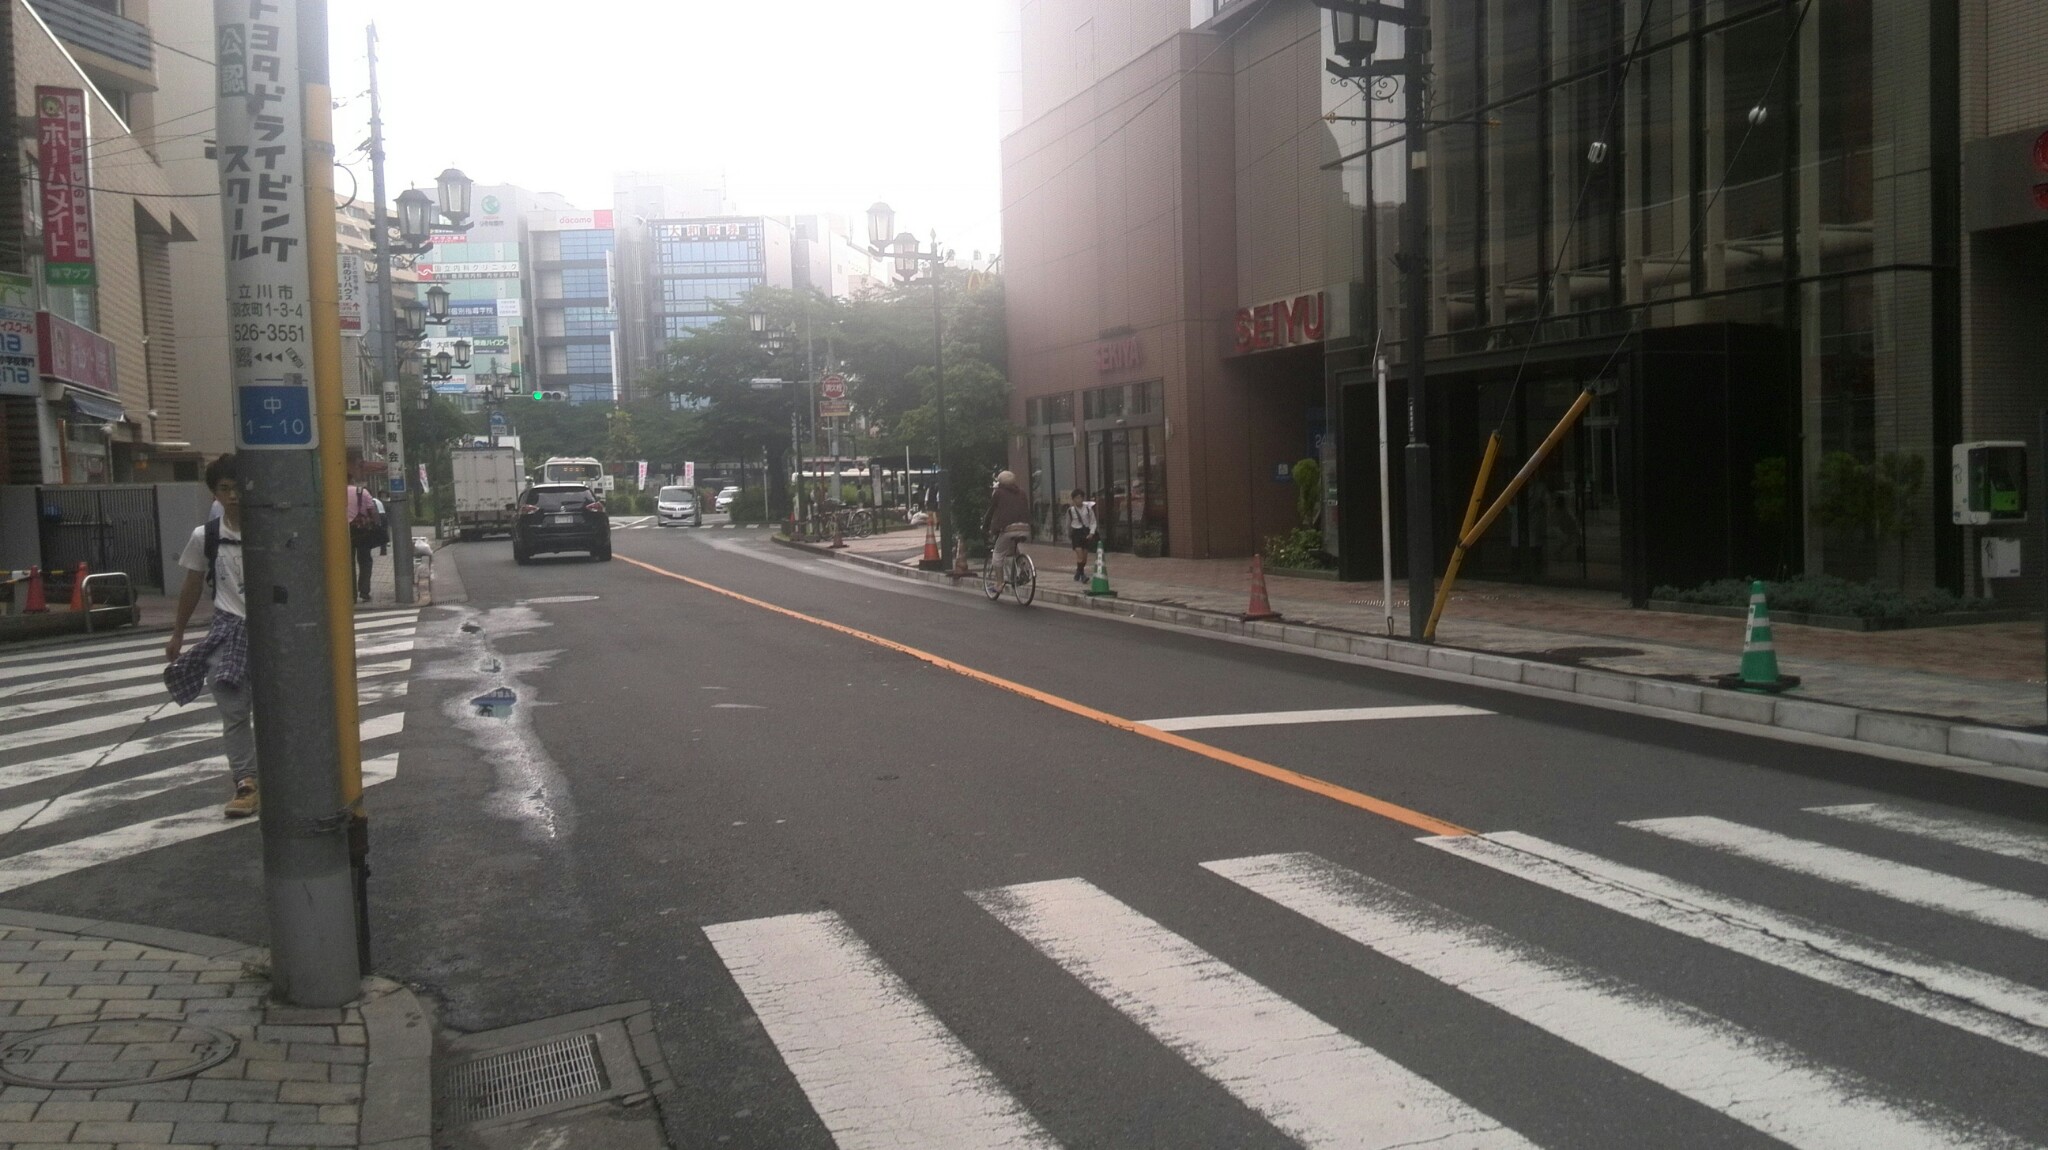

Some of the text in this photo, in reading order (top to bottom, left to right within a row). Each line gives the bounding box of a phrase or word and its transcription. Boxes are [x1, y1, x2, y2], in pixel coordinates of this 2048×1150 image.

[222, 27, 245, 94] 公認
[249, 0, 298, 262] トヨタドライビング
[42, 122, 70, 258] ホームメイト
[224, 145, 258, 261] スクール
[559, 216, 592, 225] docomo
[434, 263, 517, 273] 国立内科クリニック
[239, 284, 293, 300] 立川市
[234, 323, 304, 342] 526-3551
[1234, 292, 1324, 352] SEIYU
[264, 397, 282, 415] 中
[347, 399, 358, 410] P
[385, 391, 399, 463] 国立教会
